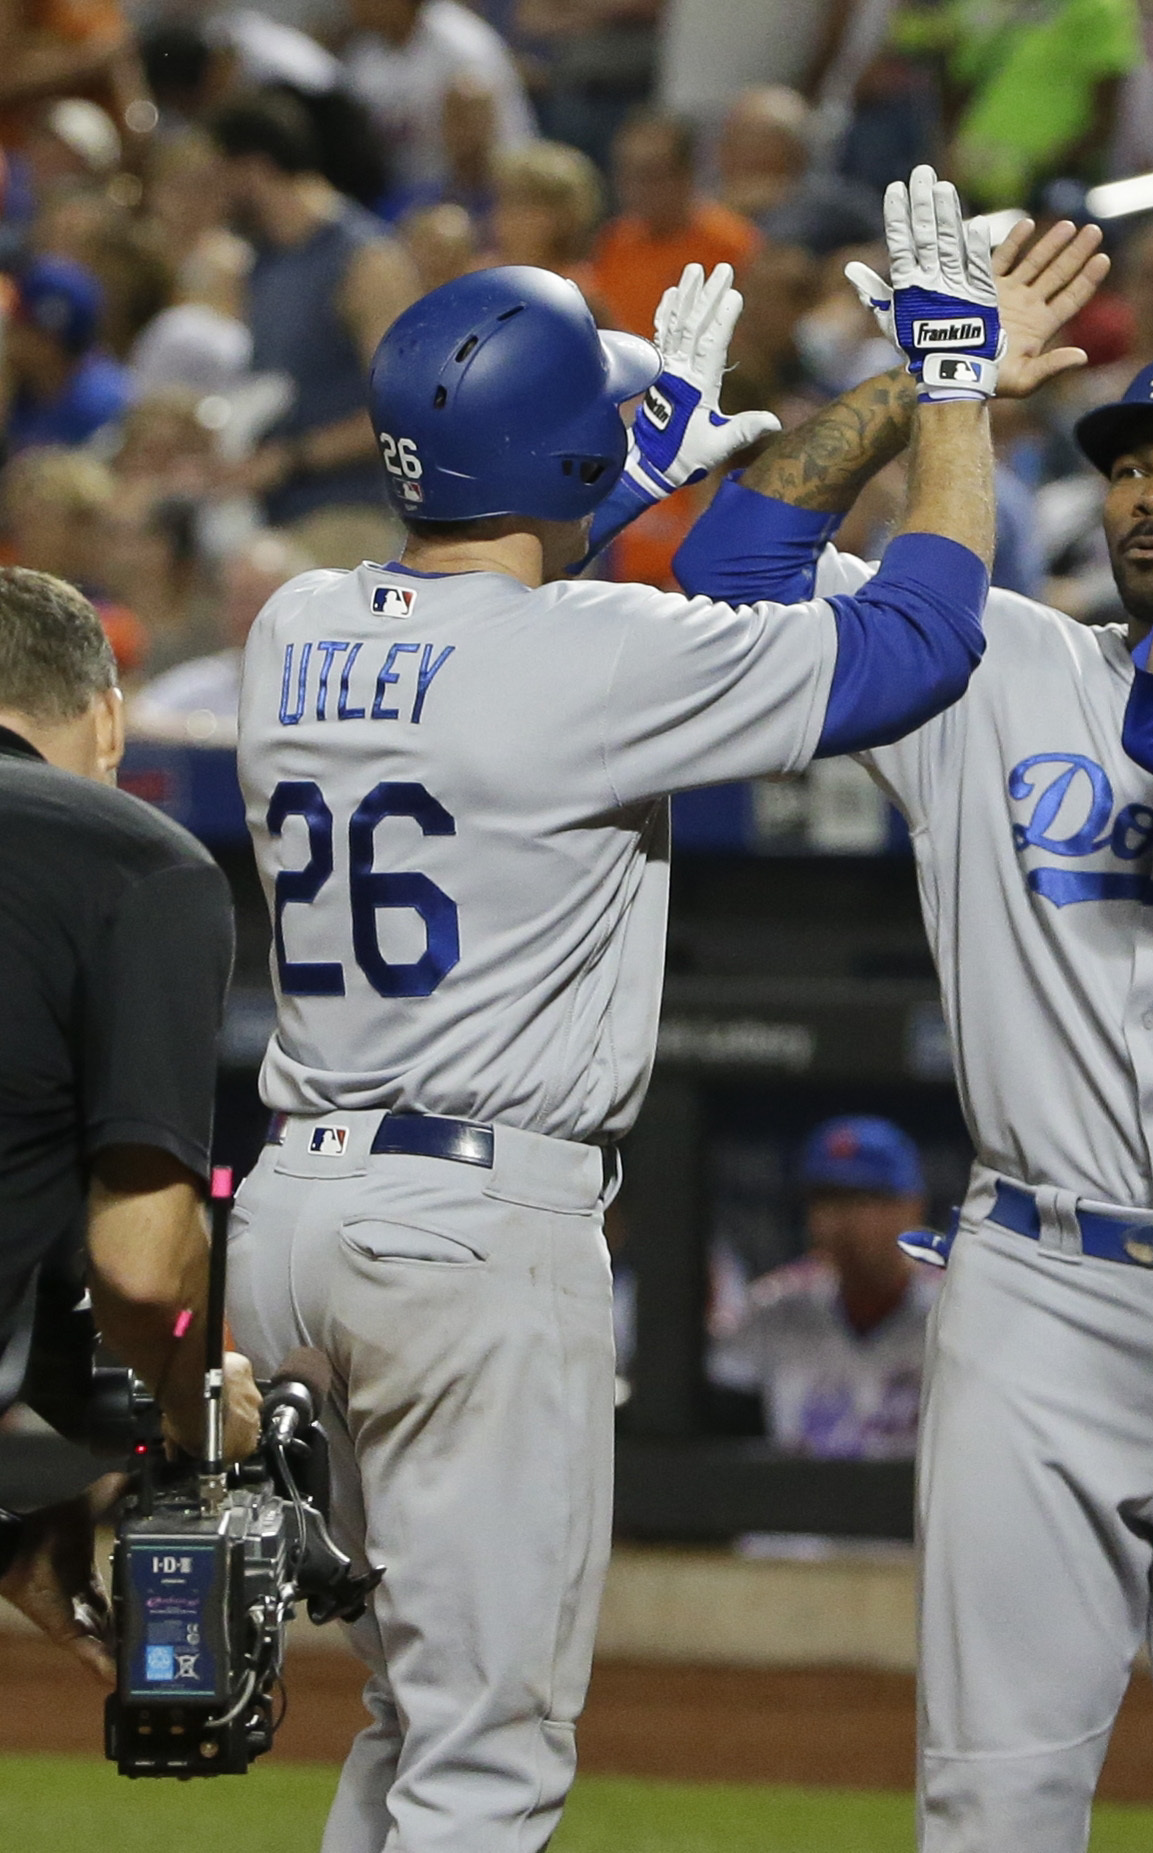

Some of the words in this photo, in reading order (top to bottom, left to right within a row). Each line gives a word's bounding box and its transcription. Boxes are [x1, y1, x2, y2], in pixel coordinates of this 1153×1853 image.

[380, 432, 422, 479] 26
[279, 641, 455, 725] UTLEY
[266, 781, 460, 998] 26
